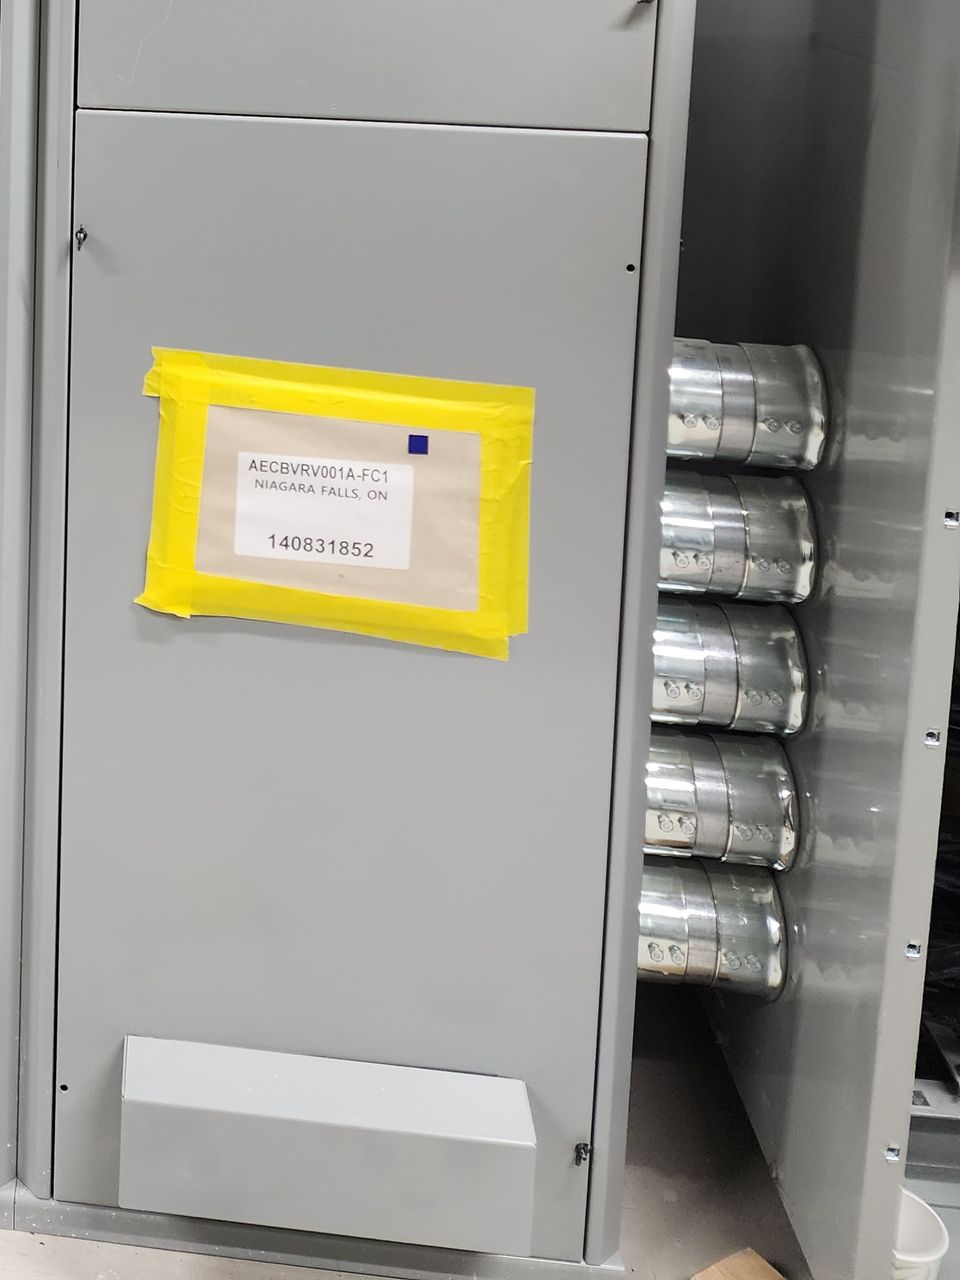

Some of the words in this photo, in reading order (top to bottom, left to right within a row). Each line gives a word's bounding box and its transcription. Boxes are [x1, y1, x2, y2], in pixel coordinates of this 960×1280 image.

[248, 459, 389, 484] AECBVRV001A-FC1
[254, 479, 316, 495] NIAGARA
[320, 485, 362, 501] FALLS,
[367, 489, 388, 501] ON
[268, 533, 374, 558] 140831852
